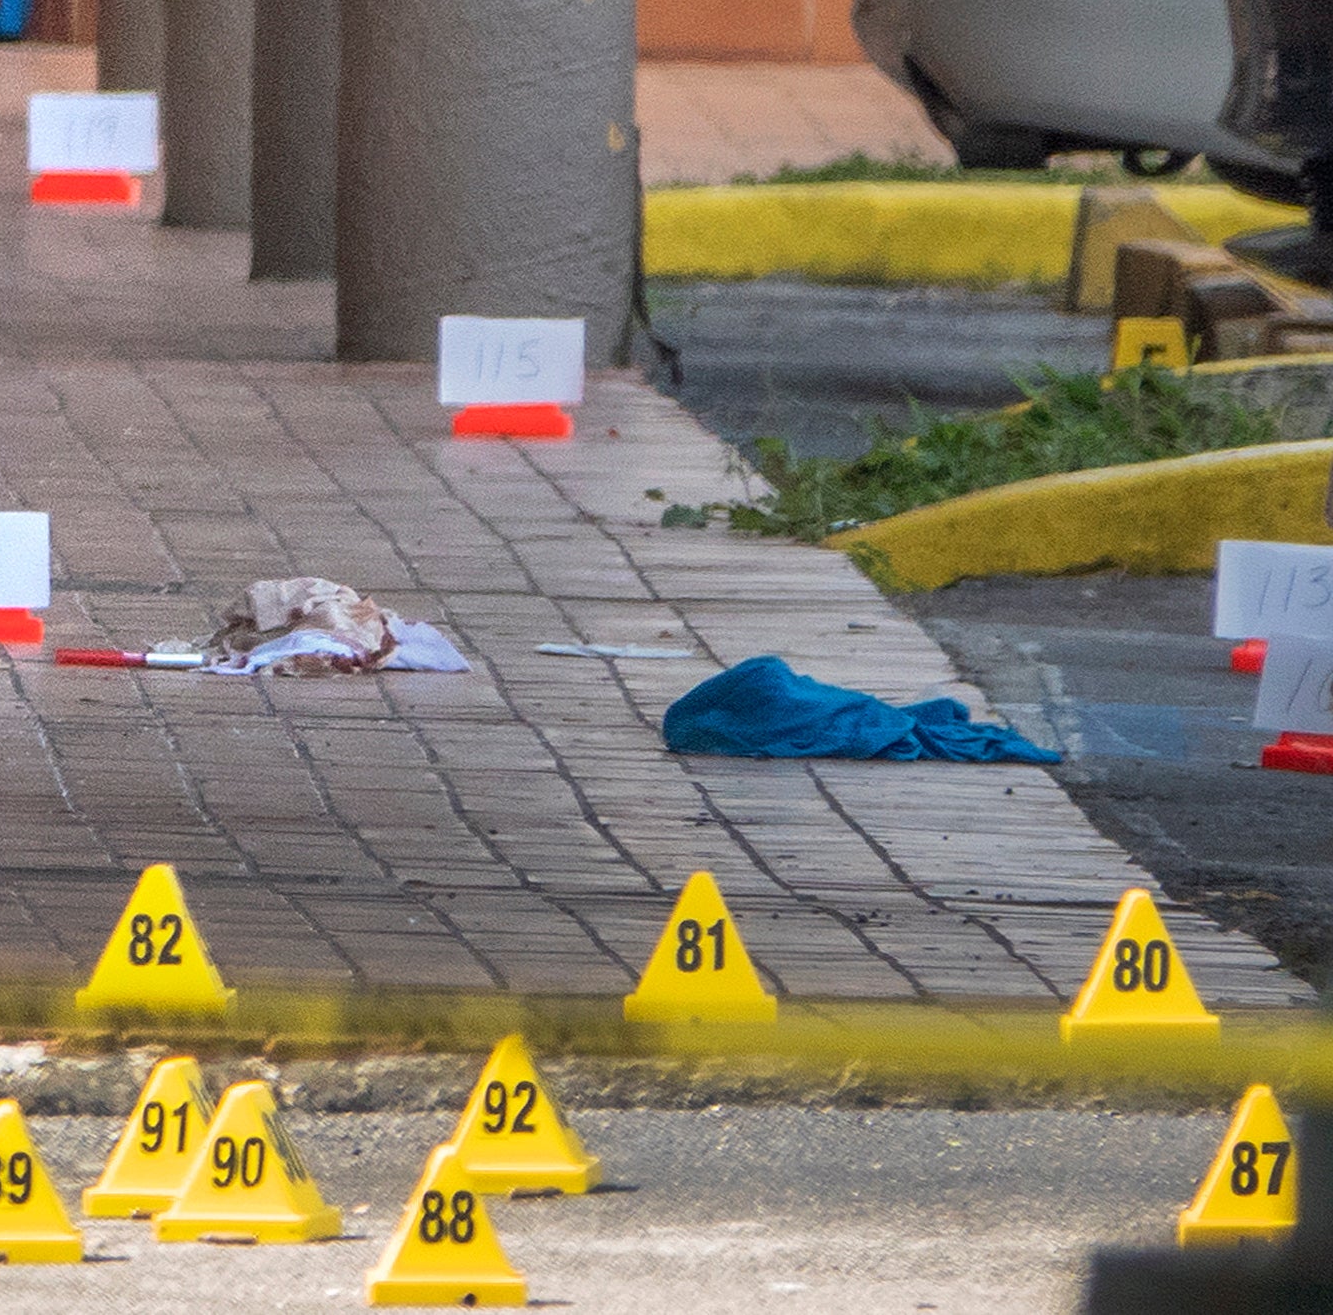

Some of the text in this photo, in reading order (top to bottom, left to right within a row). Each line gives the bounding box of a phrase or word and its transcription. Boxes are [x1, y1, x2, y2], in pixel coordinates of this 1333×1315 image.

[476, 337, 540, 384] 115
[1257, 564, 1332, 617] 113
[129, 914, 182, 966] 82
[676, 919, 724, 972] 81
[1114, 939, 1170, 992] 80
[141, 1102, 189, 1153] 91
[483, 1081, 538, 1133] 92
[213, 1136, 265, 1188] 90
[1231, 1141, 1291, 1196] 87
[419, 1190, 475, 1244] 88
